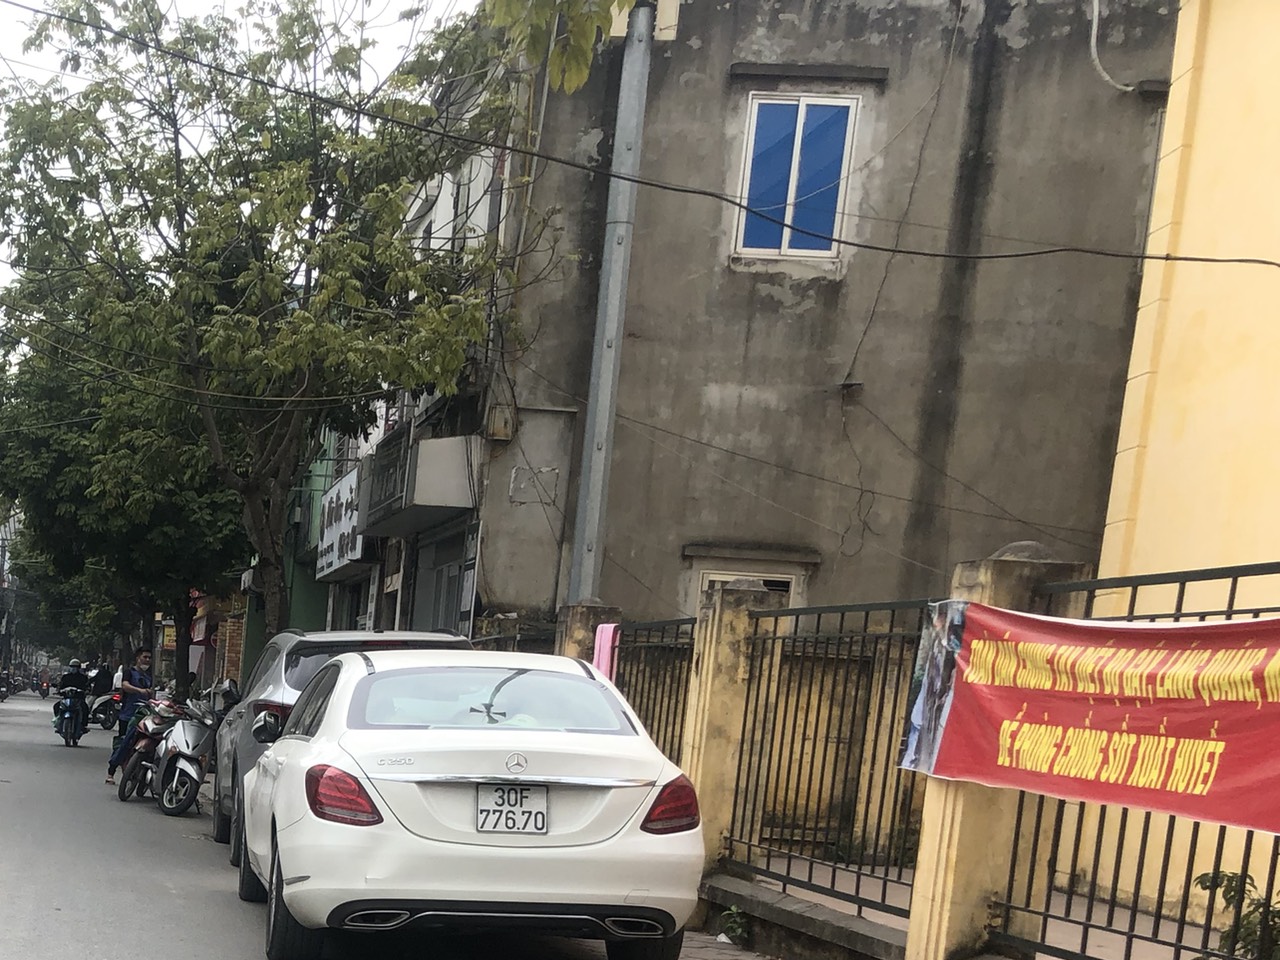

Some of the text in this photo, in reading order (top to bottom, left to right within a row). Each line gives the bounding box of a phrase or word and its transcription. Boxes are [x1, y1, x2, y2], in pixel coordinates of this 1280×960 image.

[963, 630, 997, 685] TOÀN
[994, 631, 1017, 687] DÂN
[1016, 641, 1058, 690] CHUNG
[1055, 645, 1085, 692] TAY
[1075, 639, 1117, 705] DIỆT
[1103, 648, 1137, 707] BỌ
[377, 757, 415, 766] C 250
[1012, 712, 1063, 774] PHÒNG
[1053, 711, 1108, 781] CHỐNG
[1099, 713, 1138, 784] SỐT
[1126, 716, 1176, 790] XUẤT
[1166, 719, 1226, 796] HUYẾT
[494, 787, 531, 808] 30F
[479, 809, 546, 831] 776.70
